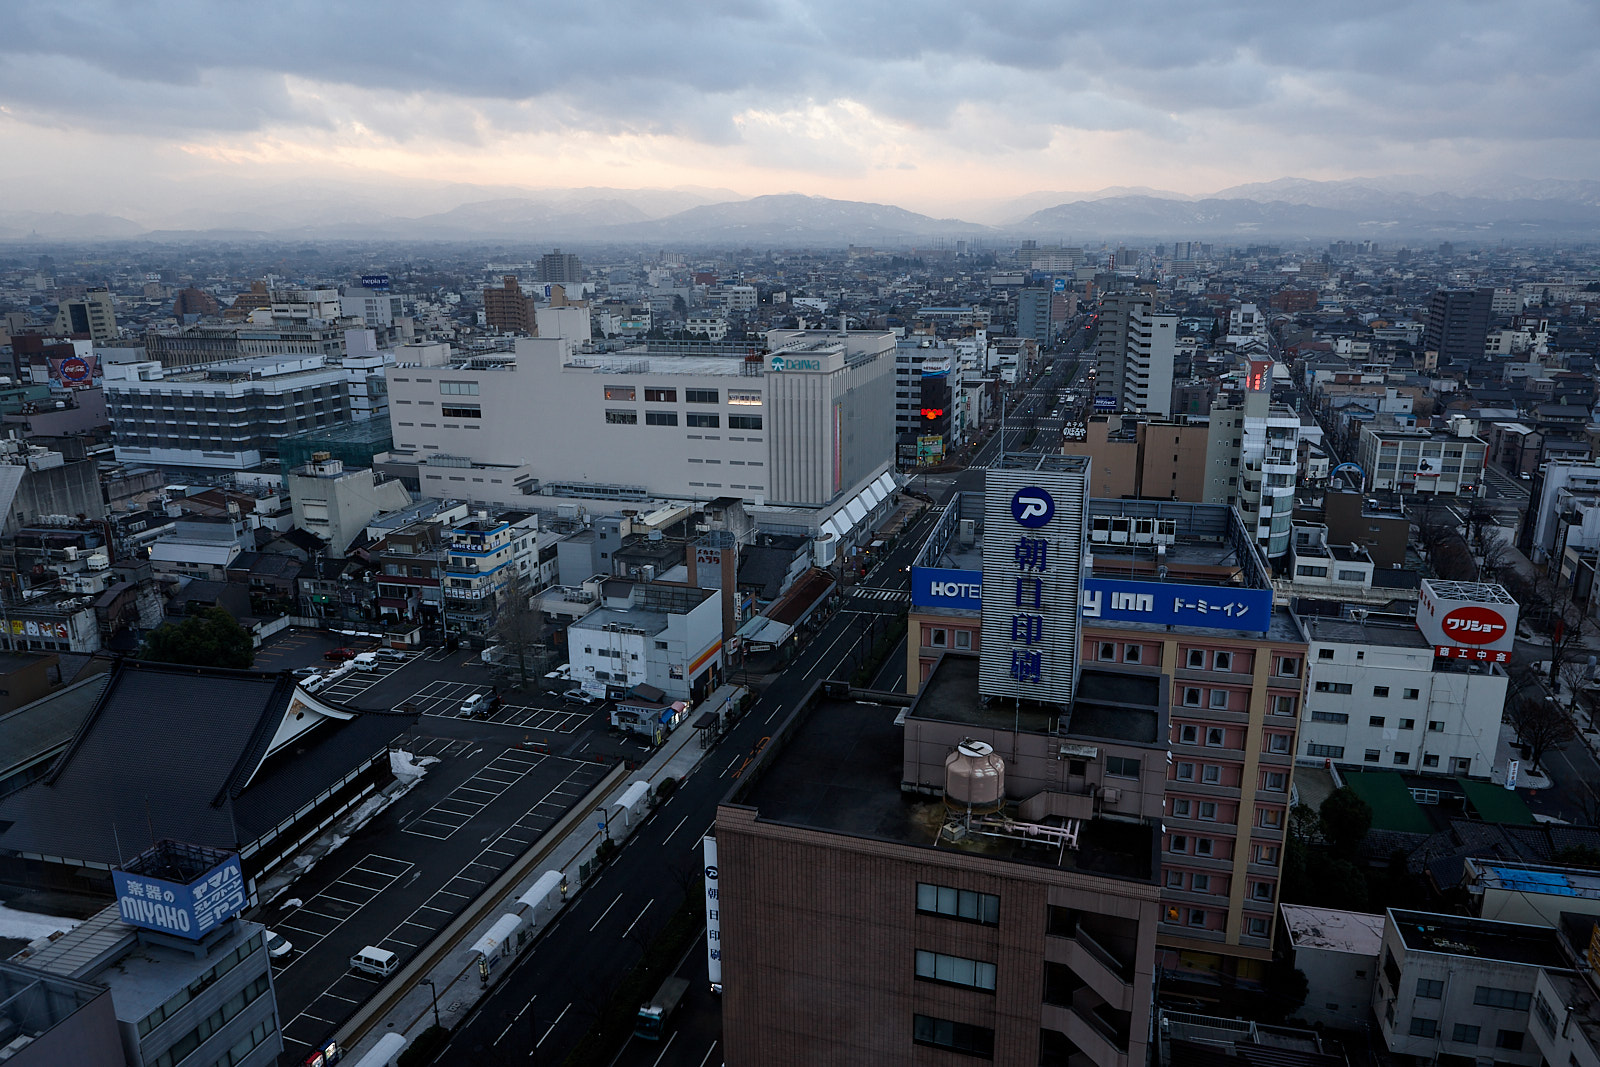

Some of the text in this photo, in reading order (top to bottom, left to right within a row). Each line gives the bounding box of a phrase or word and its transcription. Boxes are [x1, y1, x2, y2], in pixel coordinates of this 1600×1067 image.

[931, 581, 982, 599] HOTE
[1010, 536, 1049, 683] 朝日印刷
[1174, 597, 1249, 617] ドーミーイン
[1446, 618, 1504, 633] ワリショー
[1439, 647, 1507, 662] 商工中金
[127, 880, 175, 903] 楽器の
[193, 865, 239, 900] ヤマハ
[198, 891, 243, 932] ミヤコ
